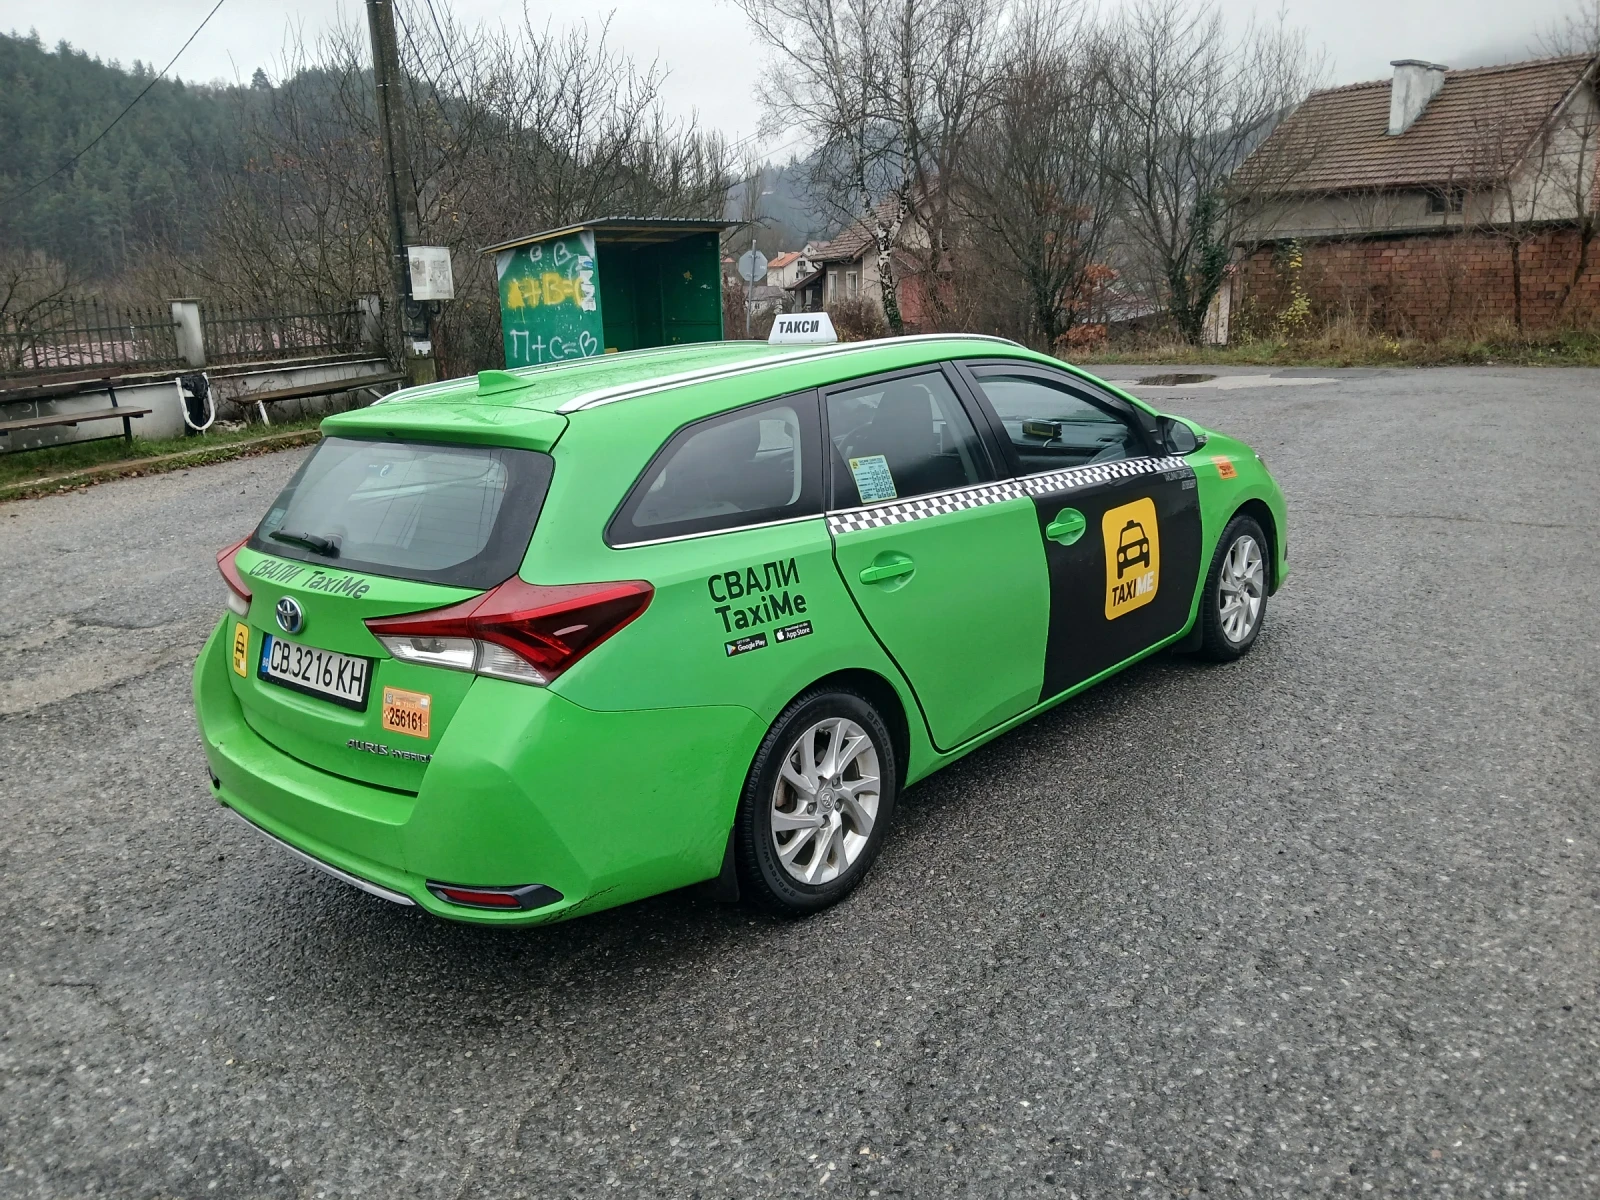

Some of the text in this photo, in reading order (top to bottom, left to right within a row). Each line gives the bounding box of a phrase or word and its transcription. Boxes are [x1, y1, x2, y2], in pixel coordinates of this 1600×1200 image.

[779, 320, 819, 334] ТАКСИ
[248, 559, 371, 599] СВАЛИ TaxiMe
[707, 557, 800, 603] СВАЛИ
[715, 590, 807, 634] TaxiMe
[786, 627, 810, 639] App Store
[737, 639, 765, 652] Google Play
[389, 707, 422, 731] 256161
[345, 738, 389, 756] AURIS
